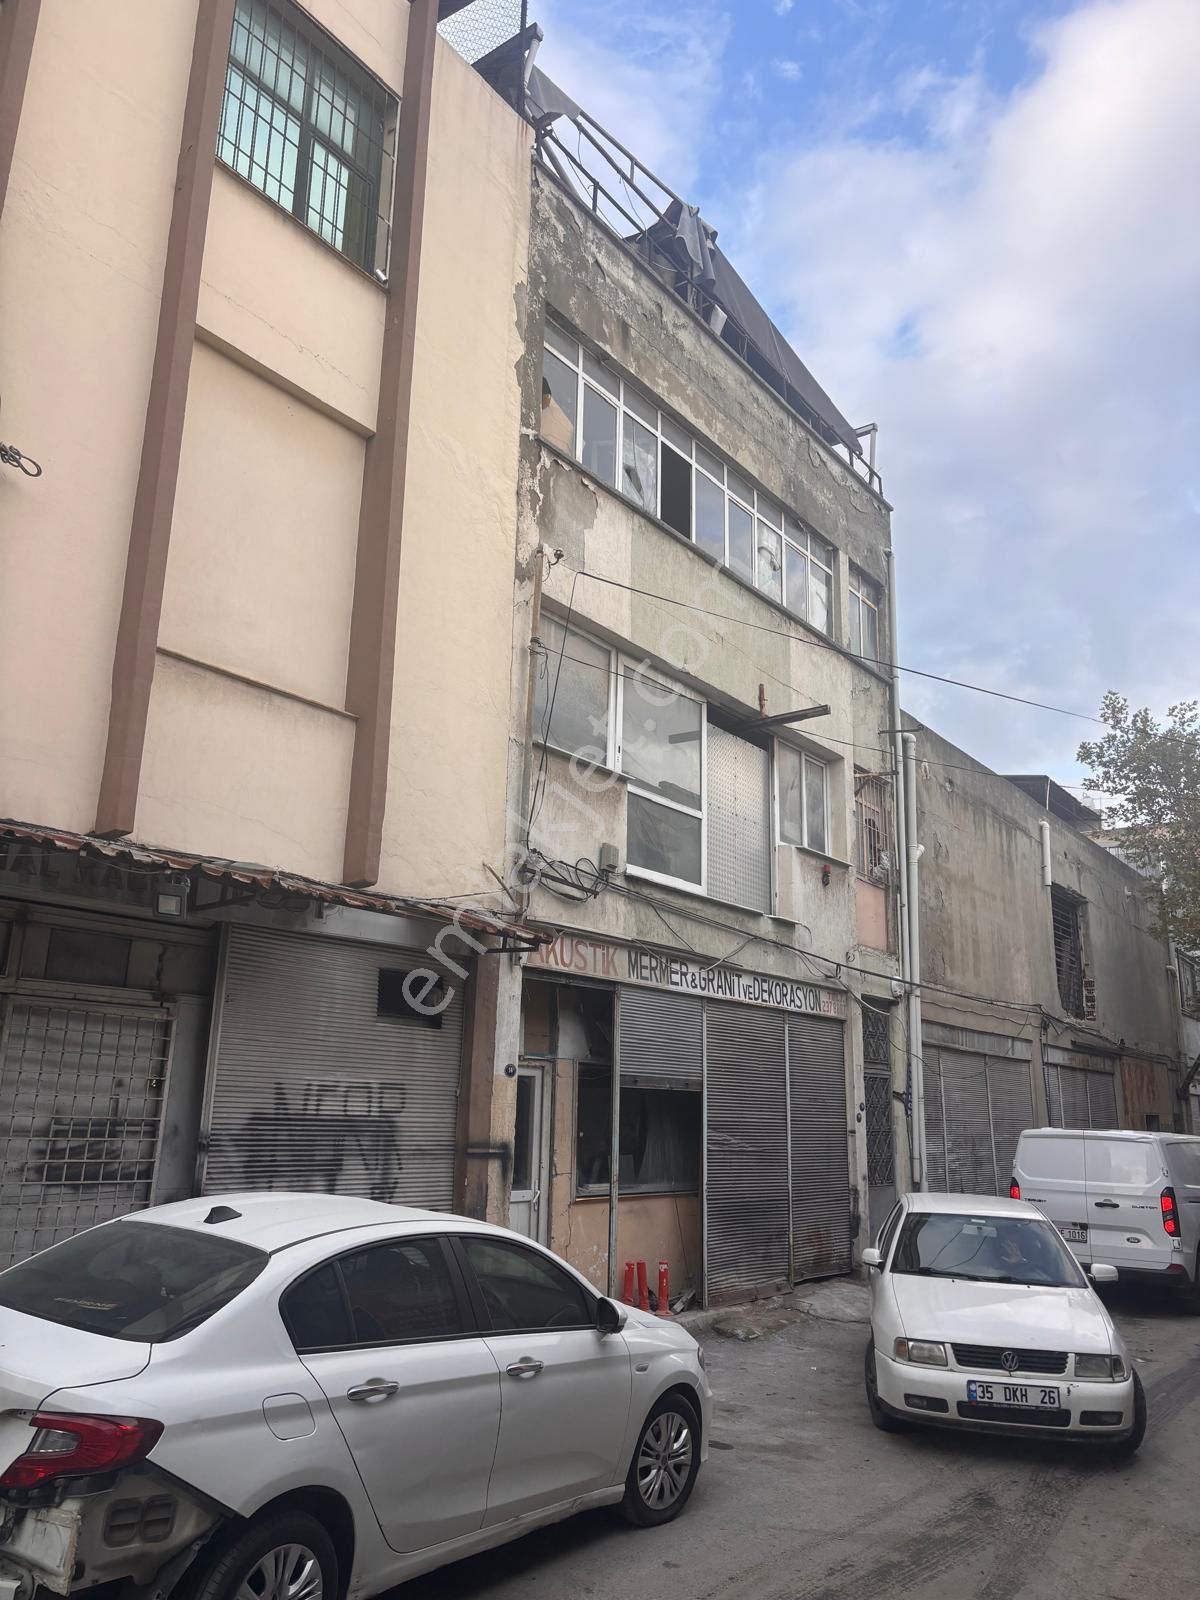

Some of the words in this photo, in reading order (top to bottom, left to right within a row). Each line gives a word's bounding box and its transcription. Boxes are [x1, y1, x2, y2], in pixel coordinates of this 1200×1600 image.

[627, 949, 689, 988] MERMER
[1068, 1230, 1086, 1240] 1016
[978, 1384, 994, 1401] 35
[1004, 1386, 1028, 1403] DKH
[1040, 1389, 1057, 1406] 26
